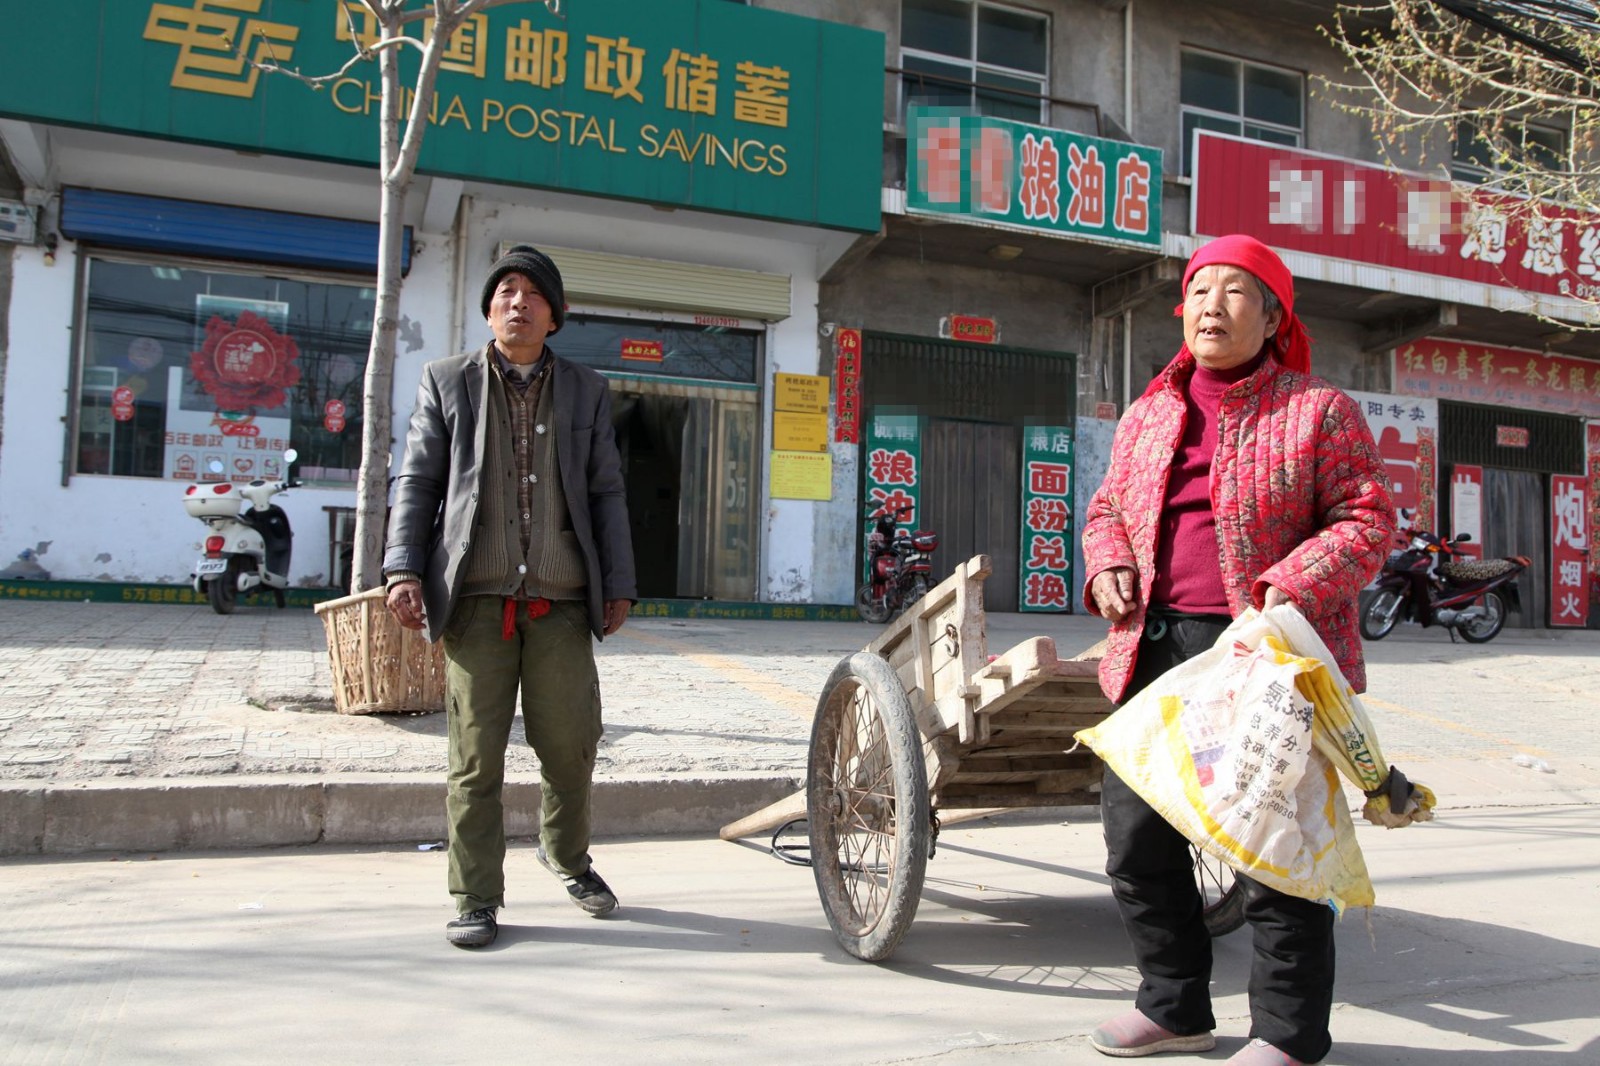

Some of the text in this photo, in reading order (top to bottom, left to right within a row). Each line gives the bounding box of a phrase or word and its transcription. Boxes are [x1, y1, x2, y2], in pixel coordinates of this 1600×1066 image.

[335, 1, 790, 128] 中国邮政储蓄
[331, 78, 787, 177] CHINA POSTAL SAVINGS
[1019, 133, 1150, 236] 粮油店
[237, 435, 290, 452] 让爱传
[1358, 400, 1426, 422] 阳专卖
[869, 449, 917, 546] 粮油
[1027, 461, 1070, 607] 面粉兑换
